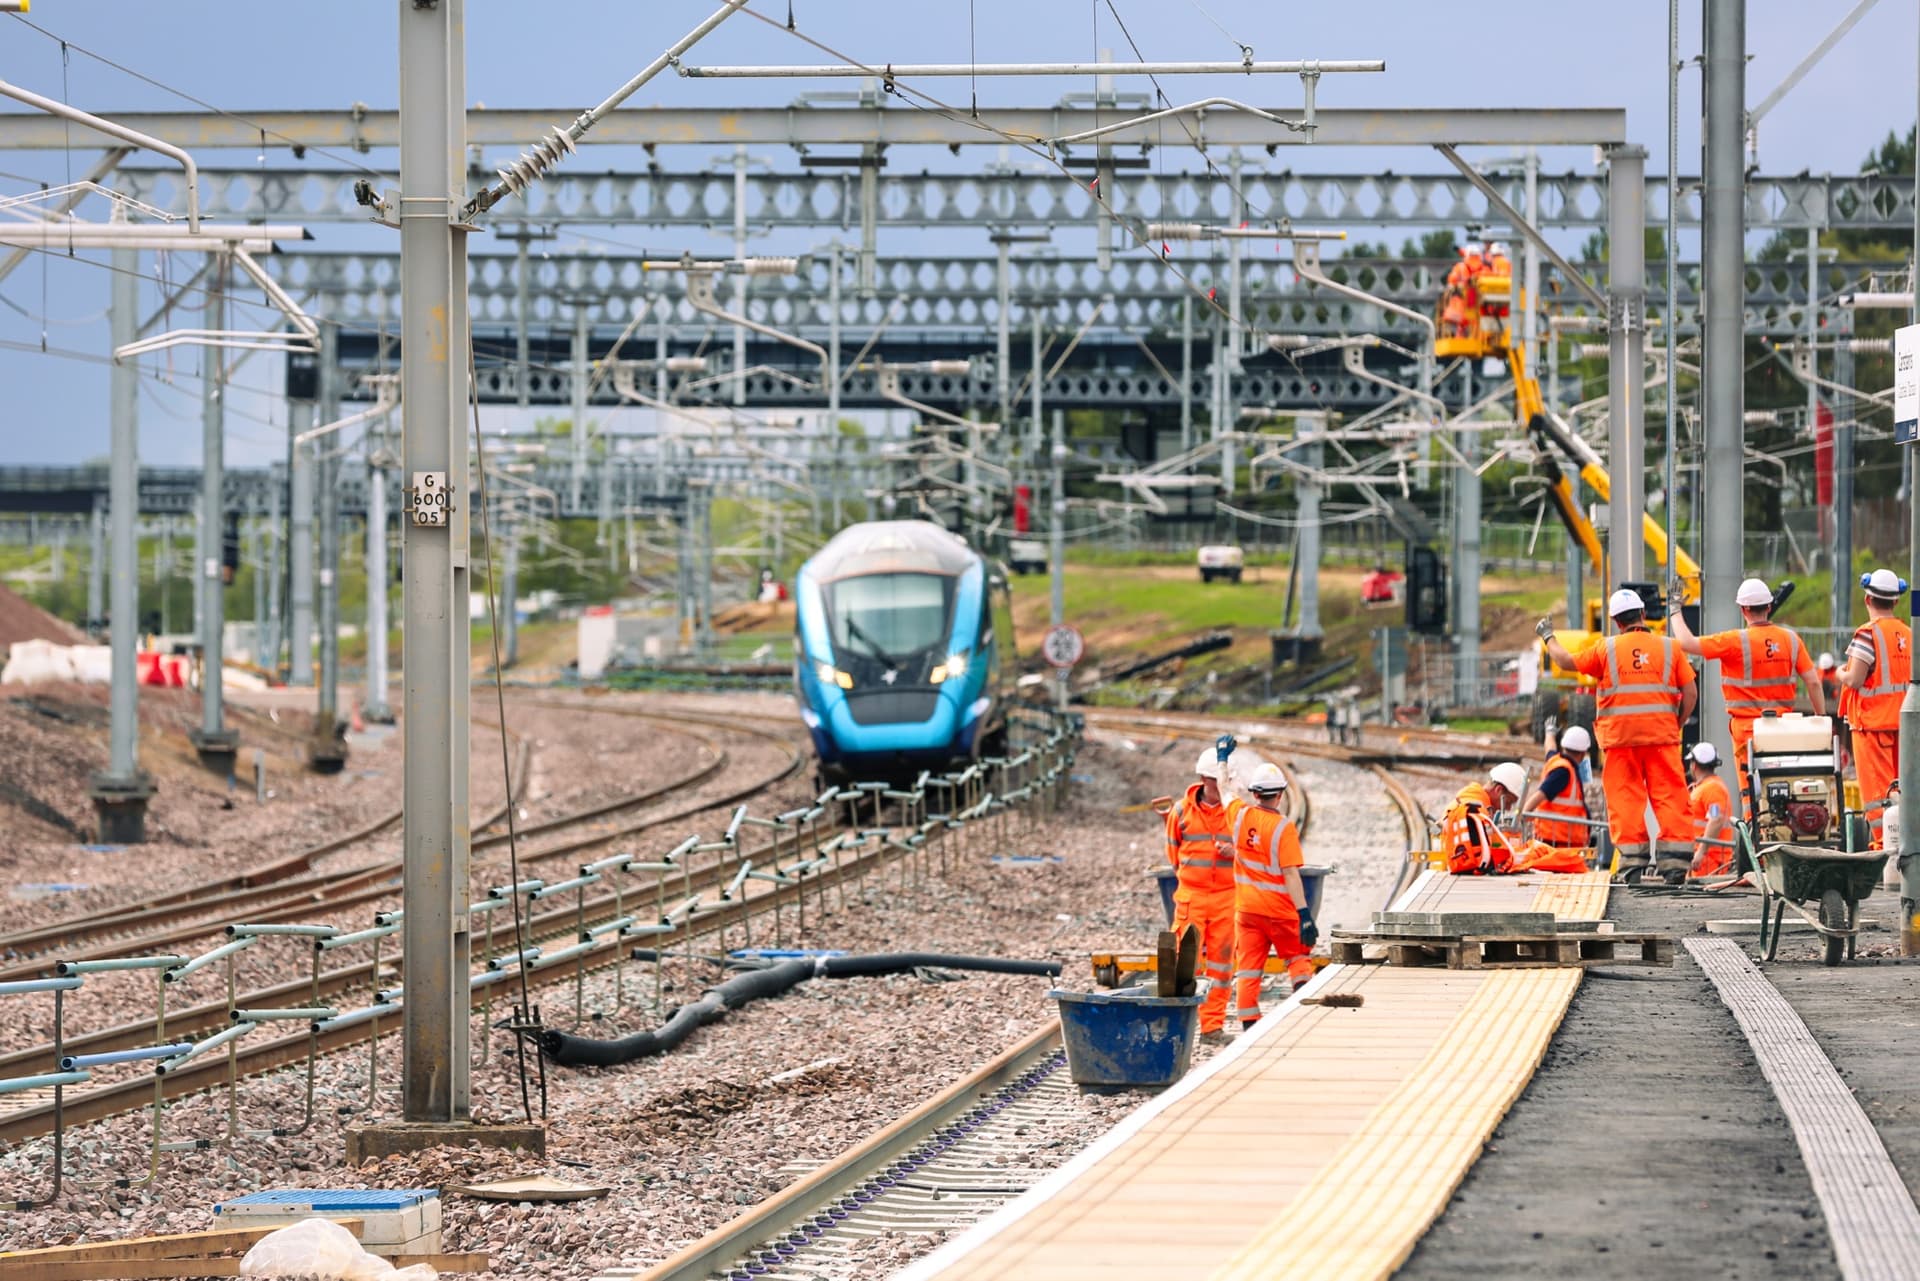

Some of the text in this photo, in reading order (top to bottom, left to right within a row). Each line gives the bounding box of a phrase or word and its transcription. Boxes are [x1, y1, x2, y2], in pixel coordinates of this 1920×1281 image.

[424, 474, 435, 488] G
[414, 493, 445, 506] 600
[418, 511, 438, 524] 05
